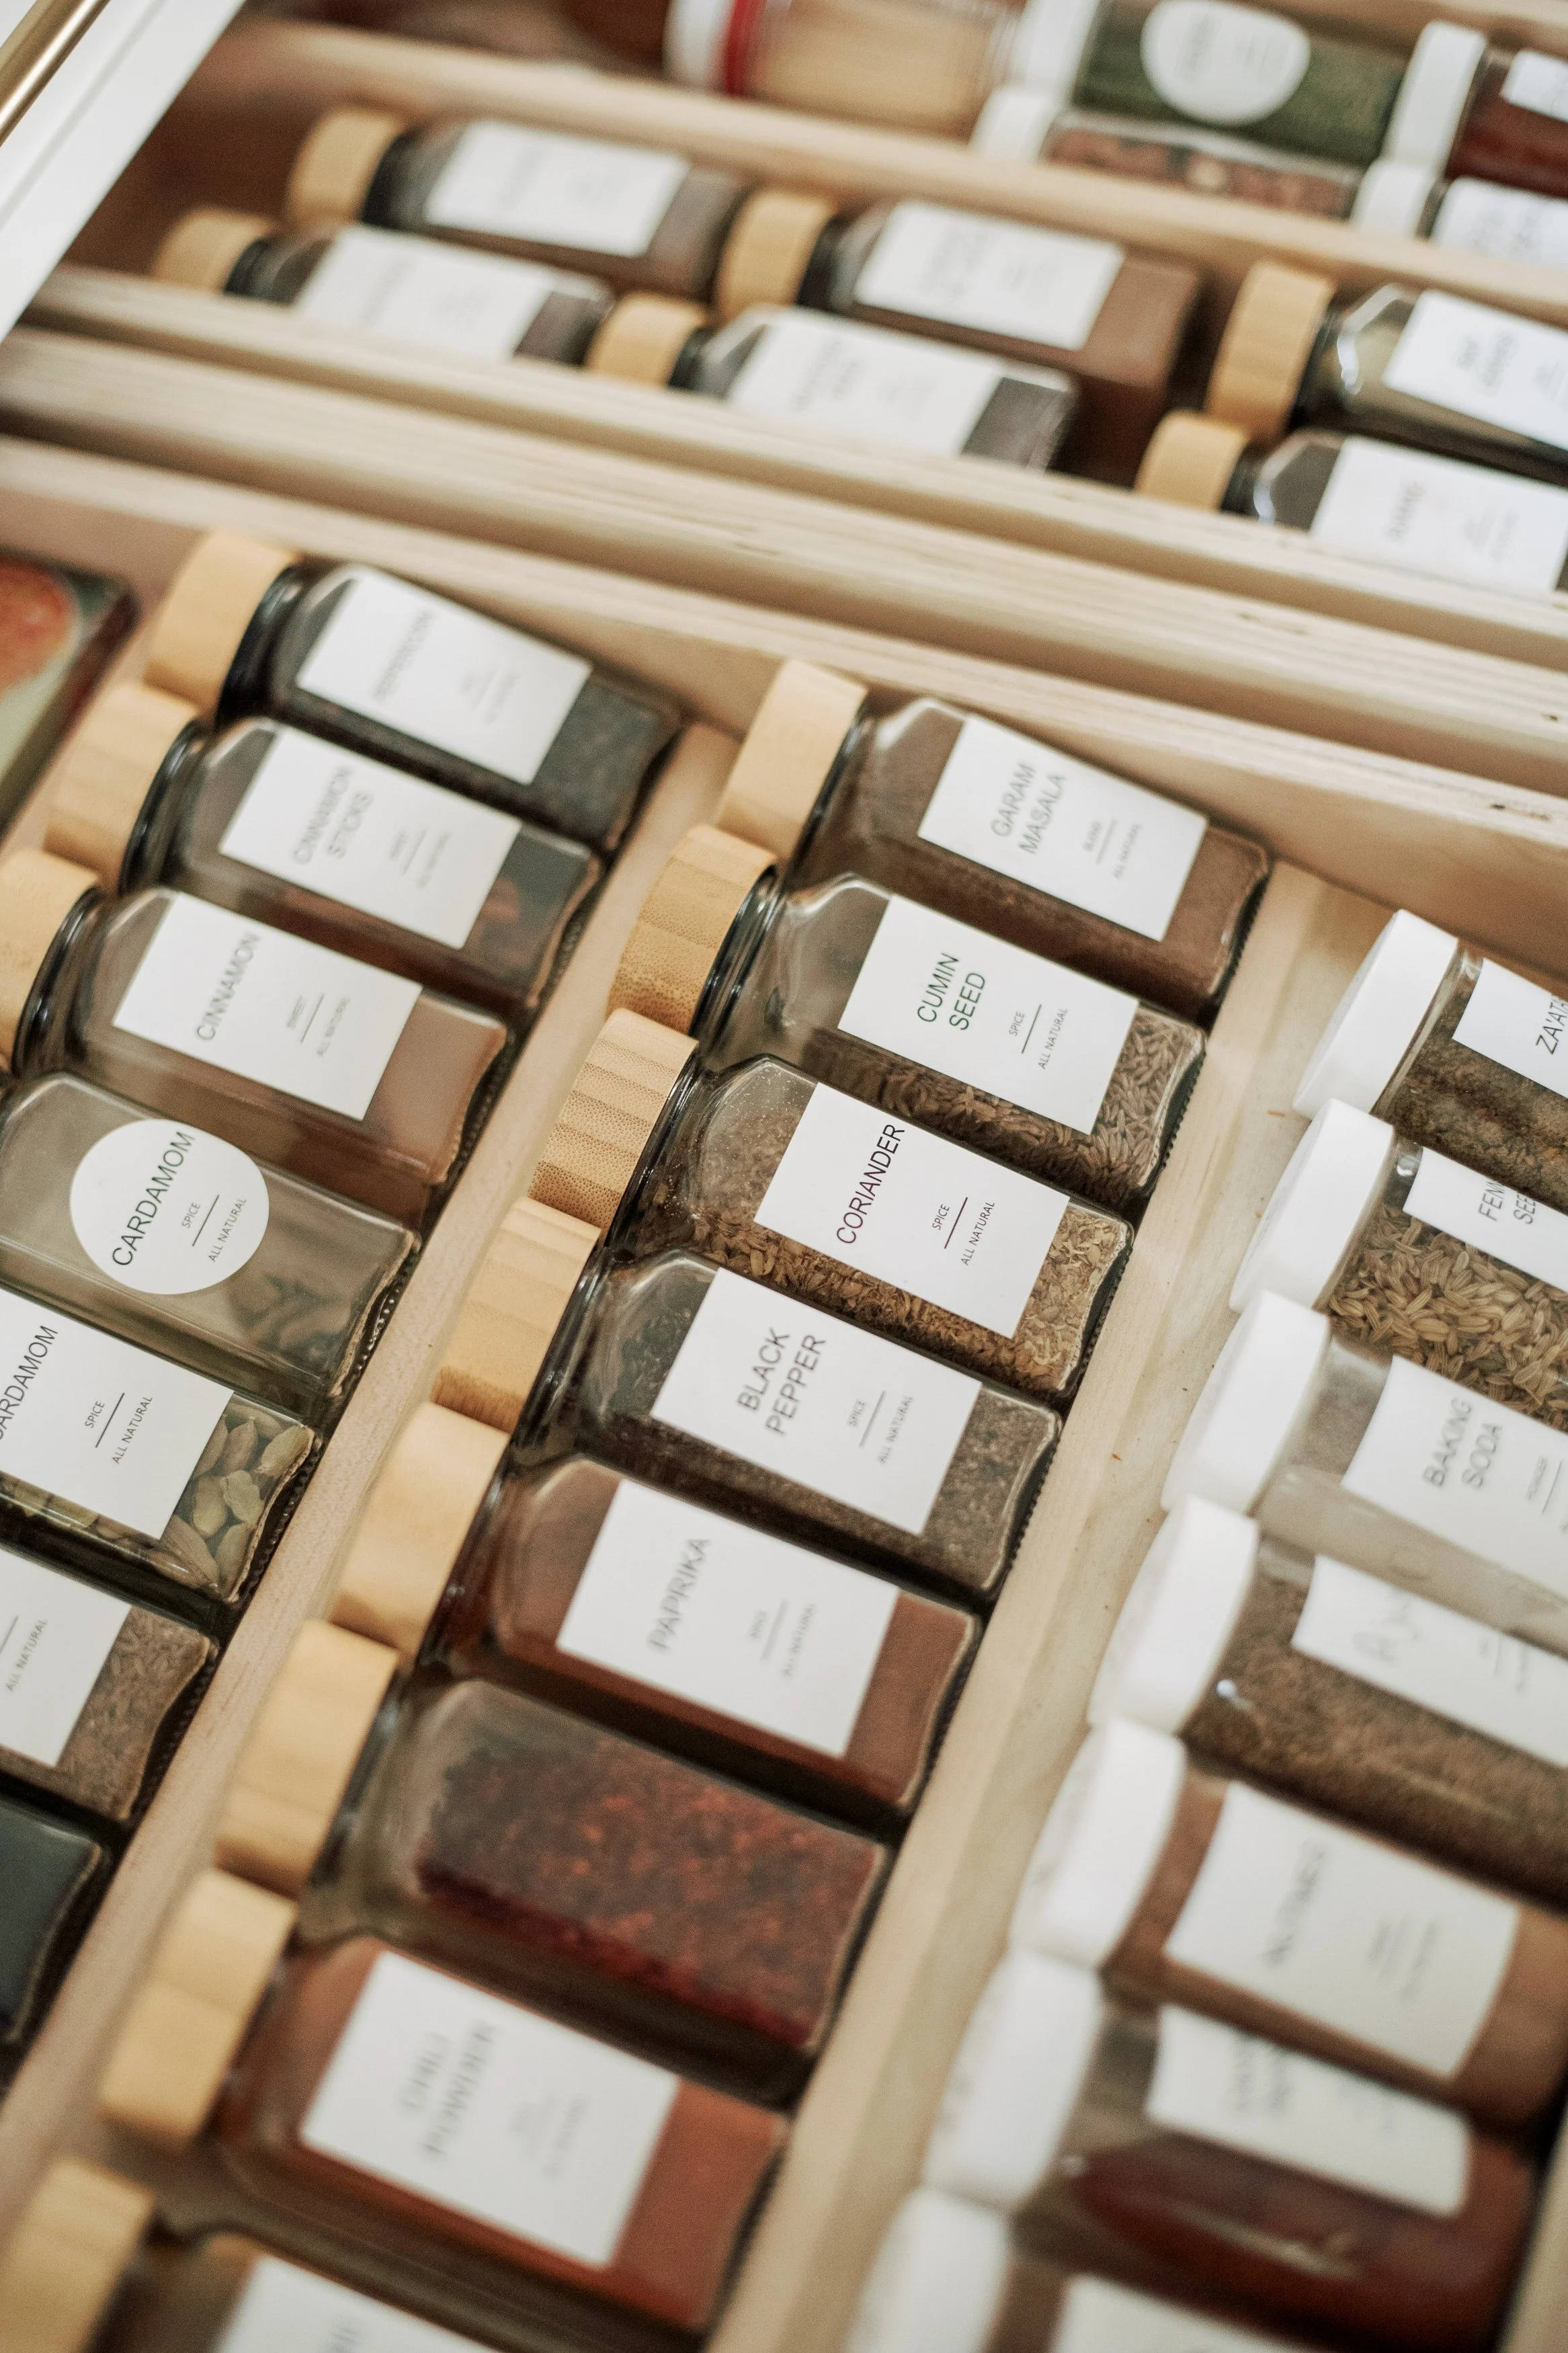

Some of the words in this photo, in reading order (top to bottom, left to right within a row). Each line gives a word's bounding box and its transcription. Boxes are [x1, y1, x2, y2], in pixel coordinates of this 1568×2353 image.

[990, 762, 1036, 837] GARAM
[1018, 774, 1066, 854] MASALA
[196, 933, 259, 1040] CINNAMON
[917, 953, 959, 1022] CUMIN
[948, 972, 985, 1030] SEED
[1008, 1011, 1025, 1036] SPICE
[1038, 1053, 1050, 1070] ALL
[1044, 1009, 1067, 1050] NATURAL
[112, 1131, 194, 1265] CARDAMOM
[181, 1202, 200, 1228] SPICE
[836, 1124, 905, 1244] CORIANDER
[932, 1203, 950, 1230] SPICE
[208, 1245, 222, 1262] ALL
[217, 1199, 246, 1242] NATURAL
[960, 1248, 975, 1265] ALL
[968, 1202, 995, 1246] NATURAL
[736, 1328, 790, 1411] BLACK
[765, 1334, 825, 1435] PEPPER
[84, 1400, 105, 1428] SPICE
[112, 1447, 127, 1464] ALL
[121, 1397, 153, 1443] NATURAL
[847, 1399, 866, 1427] SPICE
[885, 1396, 913, 1442] NATURAL
[1422, 1398, 1472, 1488] BAKING
[1461, 1423, 1502, 1490] SODA
[647, 1539, 709, 1652] PAPRIKA
[5, 1673, 19, 1691] ALL
[15, 1620, 46, 1669] NATURAL
